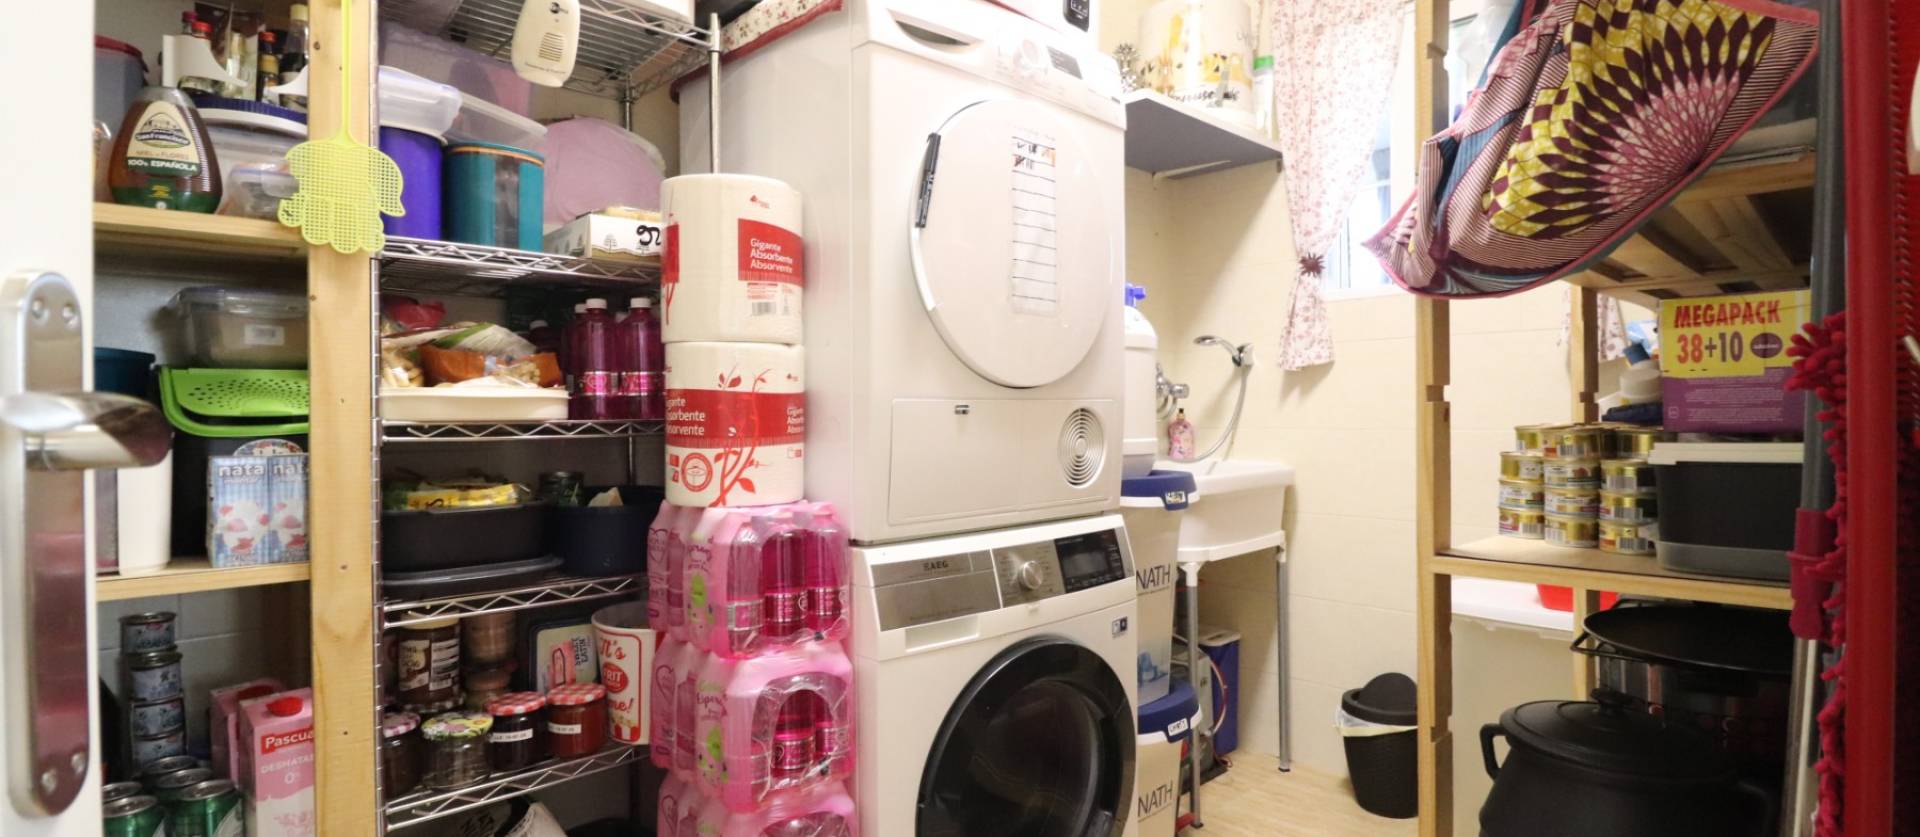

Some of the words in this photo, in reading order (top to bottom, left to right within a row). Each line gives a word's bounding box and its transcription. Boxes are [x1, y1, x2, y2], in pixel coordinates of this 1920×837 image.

[151, 160, 197, 172] ESPAÑOLA
[750, 238, 781, 252] Gigante
[750, 248, 793, 264] Absorbente
[750, 260, 793, 273] Absorvente
[1674, 300, 1781, 329] MEGAPACK
[1677, 330, 1743, 364] 38+10
[219, 463, 265, 477] nata
